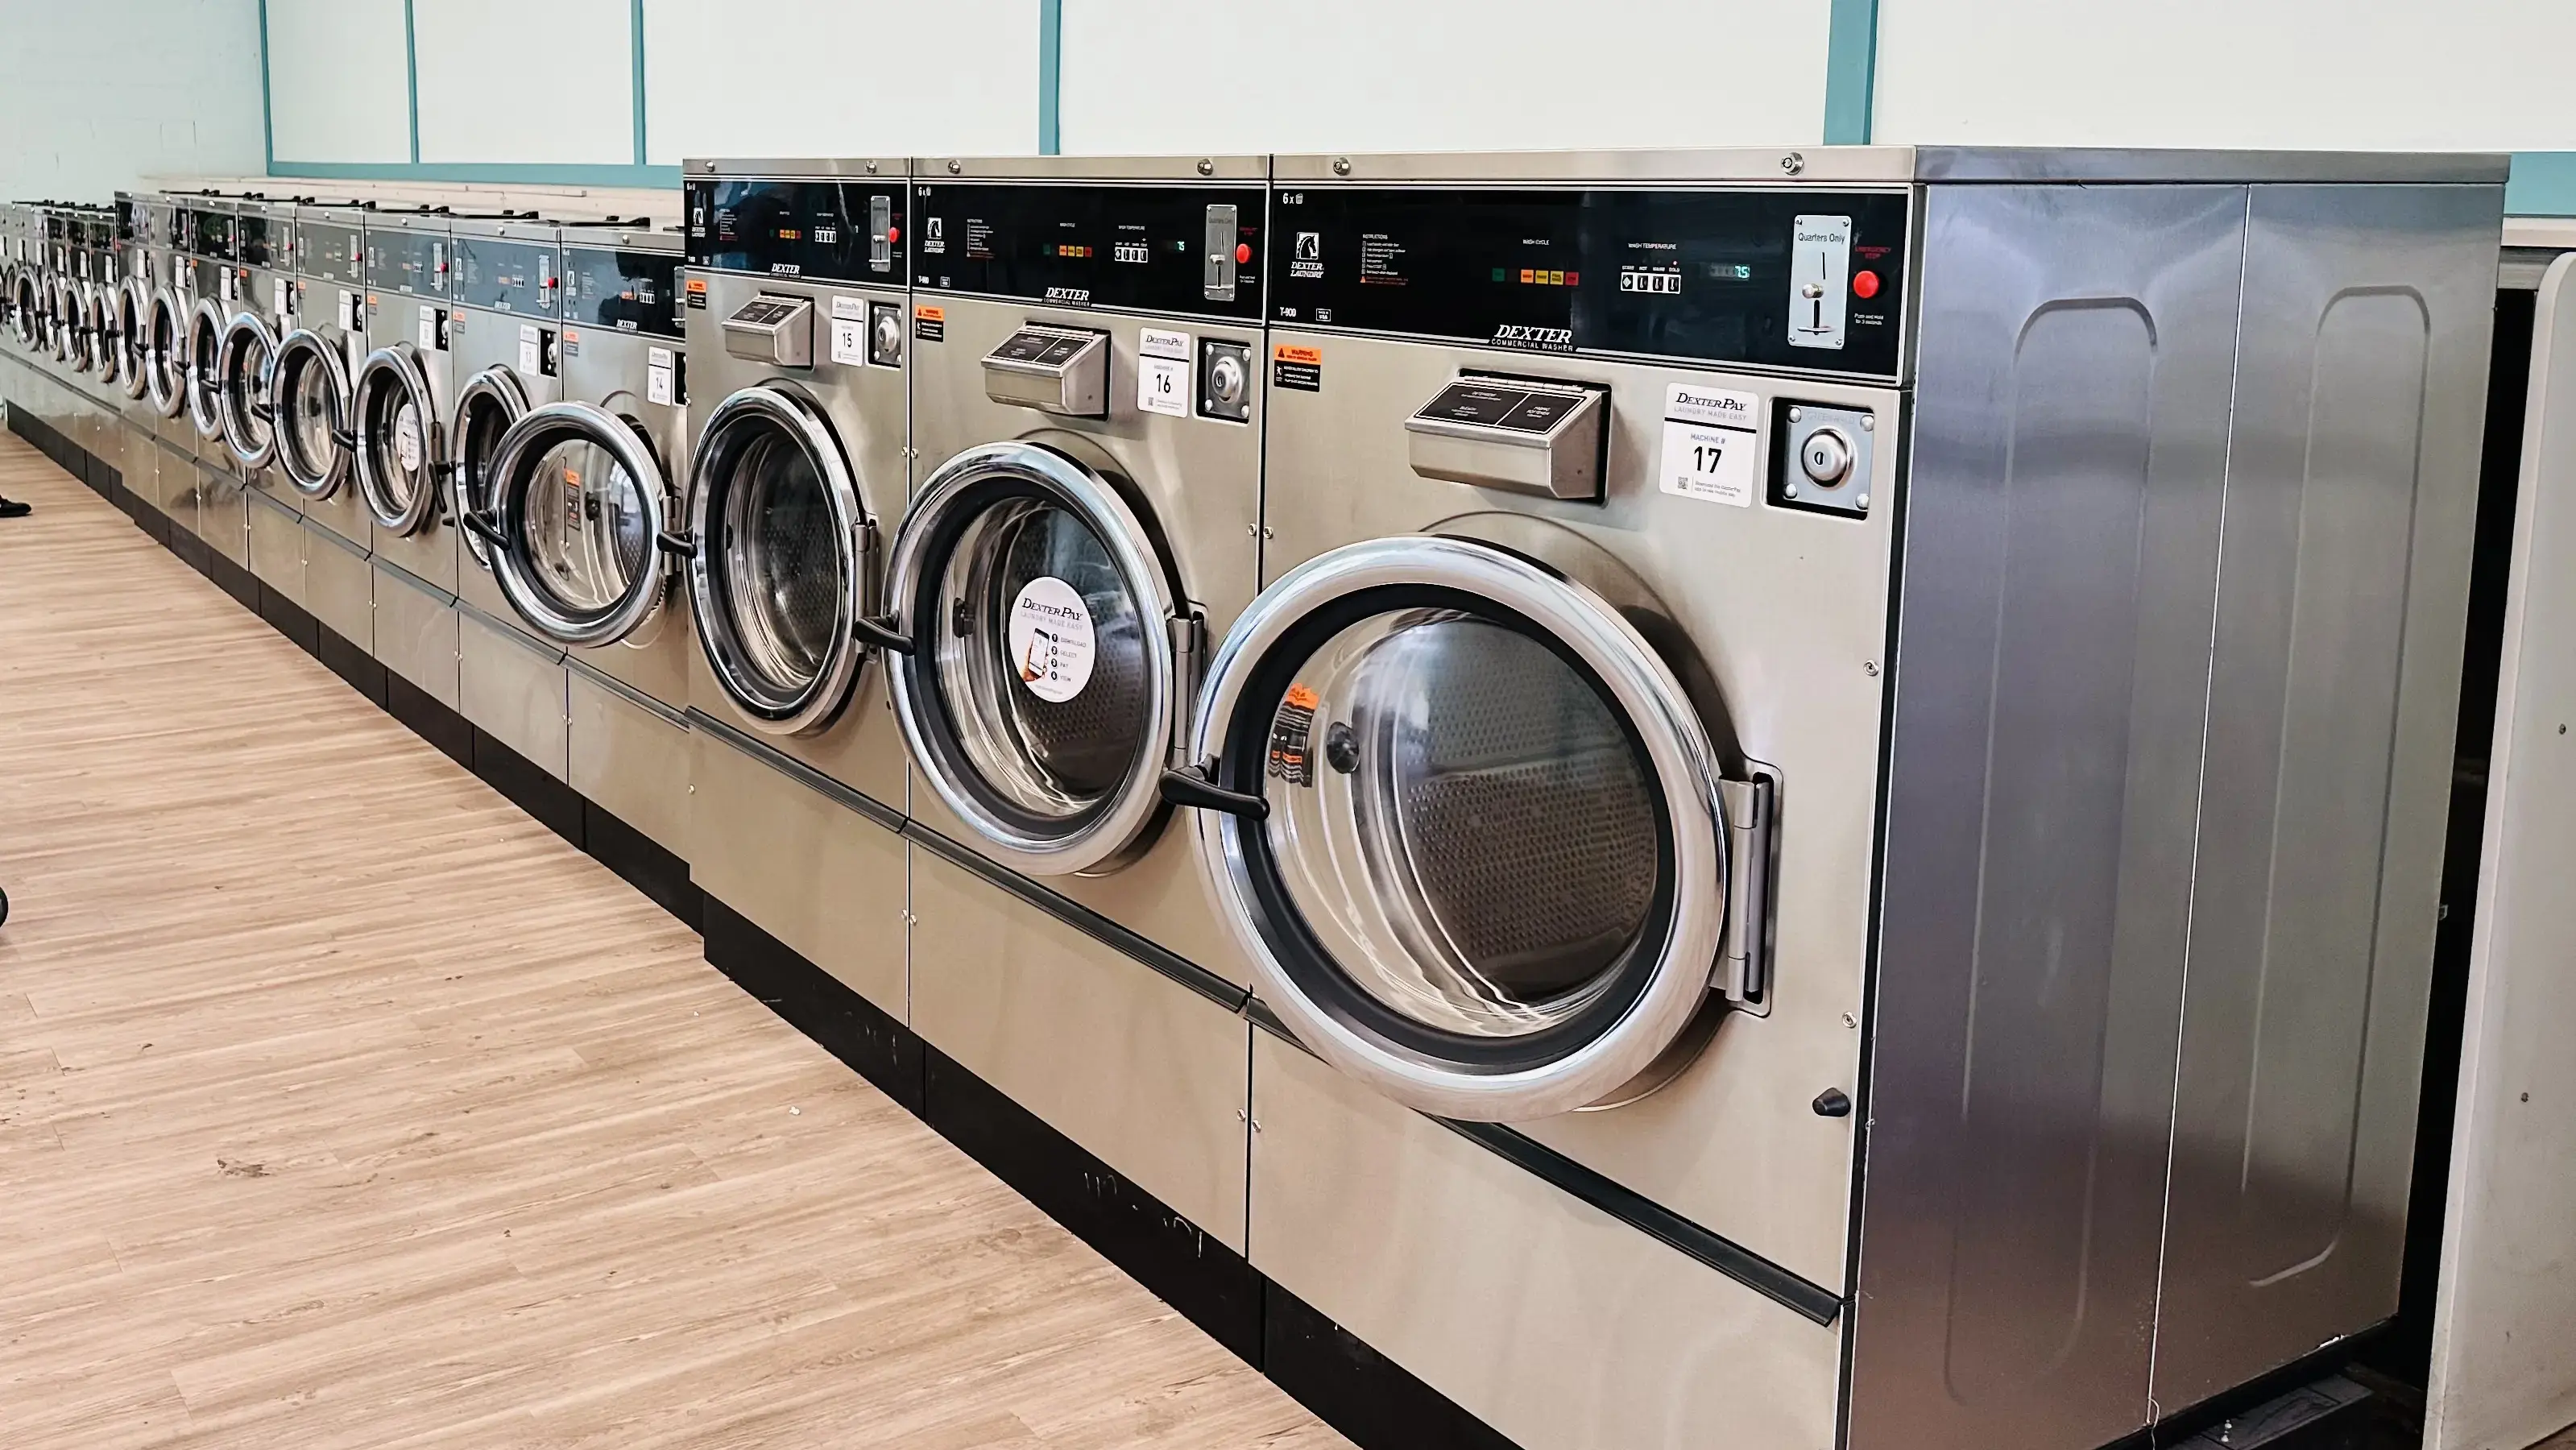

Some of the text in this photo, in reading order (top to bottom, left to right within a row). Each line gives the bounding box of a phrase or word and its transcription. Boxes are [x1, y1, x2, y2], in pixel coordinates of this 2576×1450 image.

[1798, 232, 1845, 244] Quarters Only
[771, 263, 800, 275] DEXTER
[1291, 261, 1324, 271] DEXTER
[1290, 270, 1324, 278] LAUNDRY
[1045, 287, 1090, 301] DEXTER
[616, 318, 638, 329] DEXTER
[843, 332, 852, 348] 15
[1494, 324, 1572, 344] DEXTER
[1491, 338, 1573, 352] COMMERCIAL WASHER
[656, 377, 663, 390] 14
[1156, 373, 1171, 394] 16
[1674, 406, 1747, 421] LAUNDRY MADE EASY
[1691, 433, 1719, 443] MACHINE
[1693, 445, 1722, 474] 17
[1020, 610, 1083, 631] LAUNDRY MADE EASY
